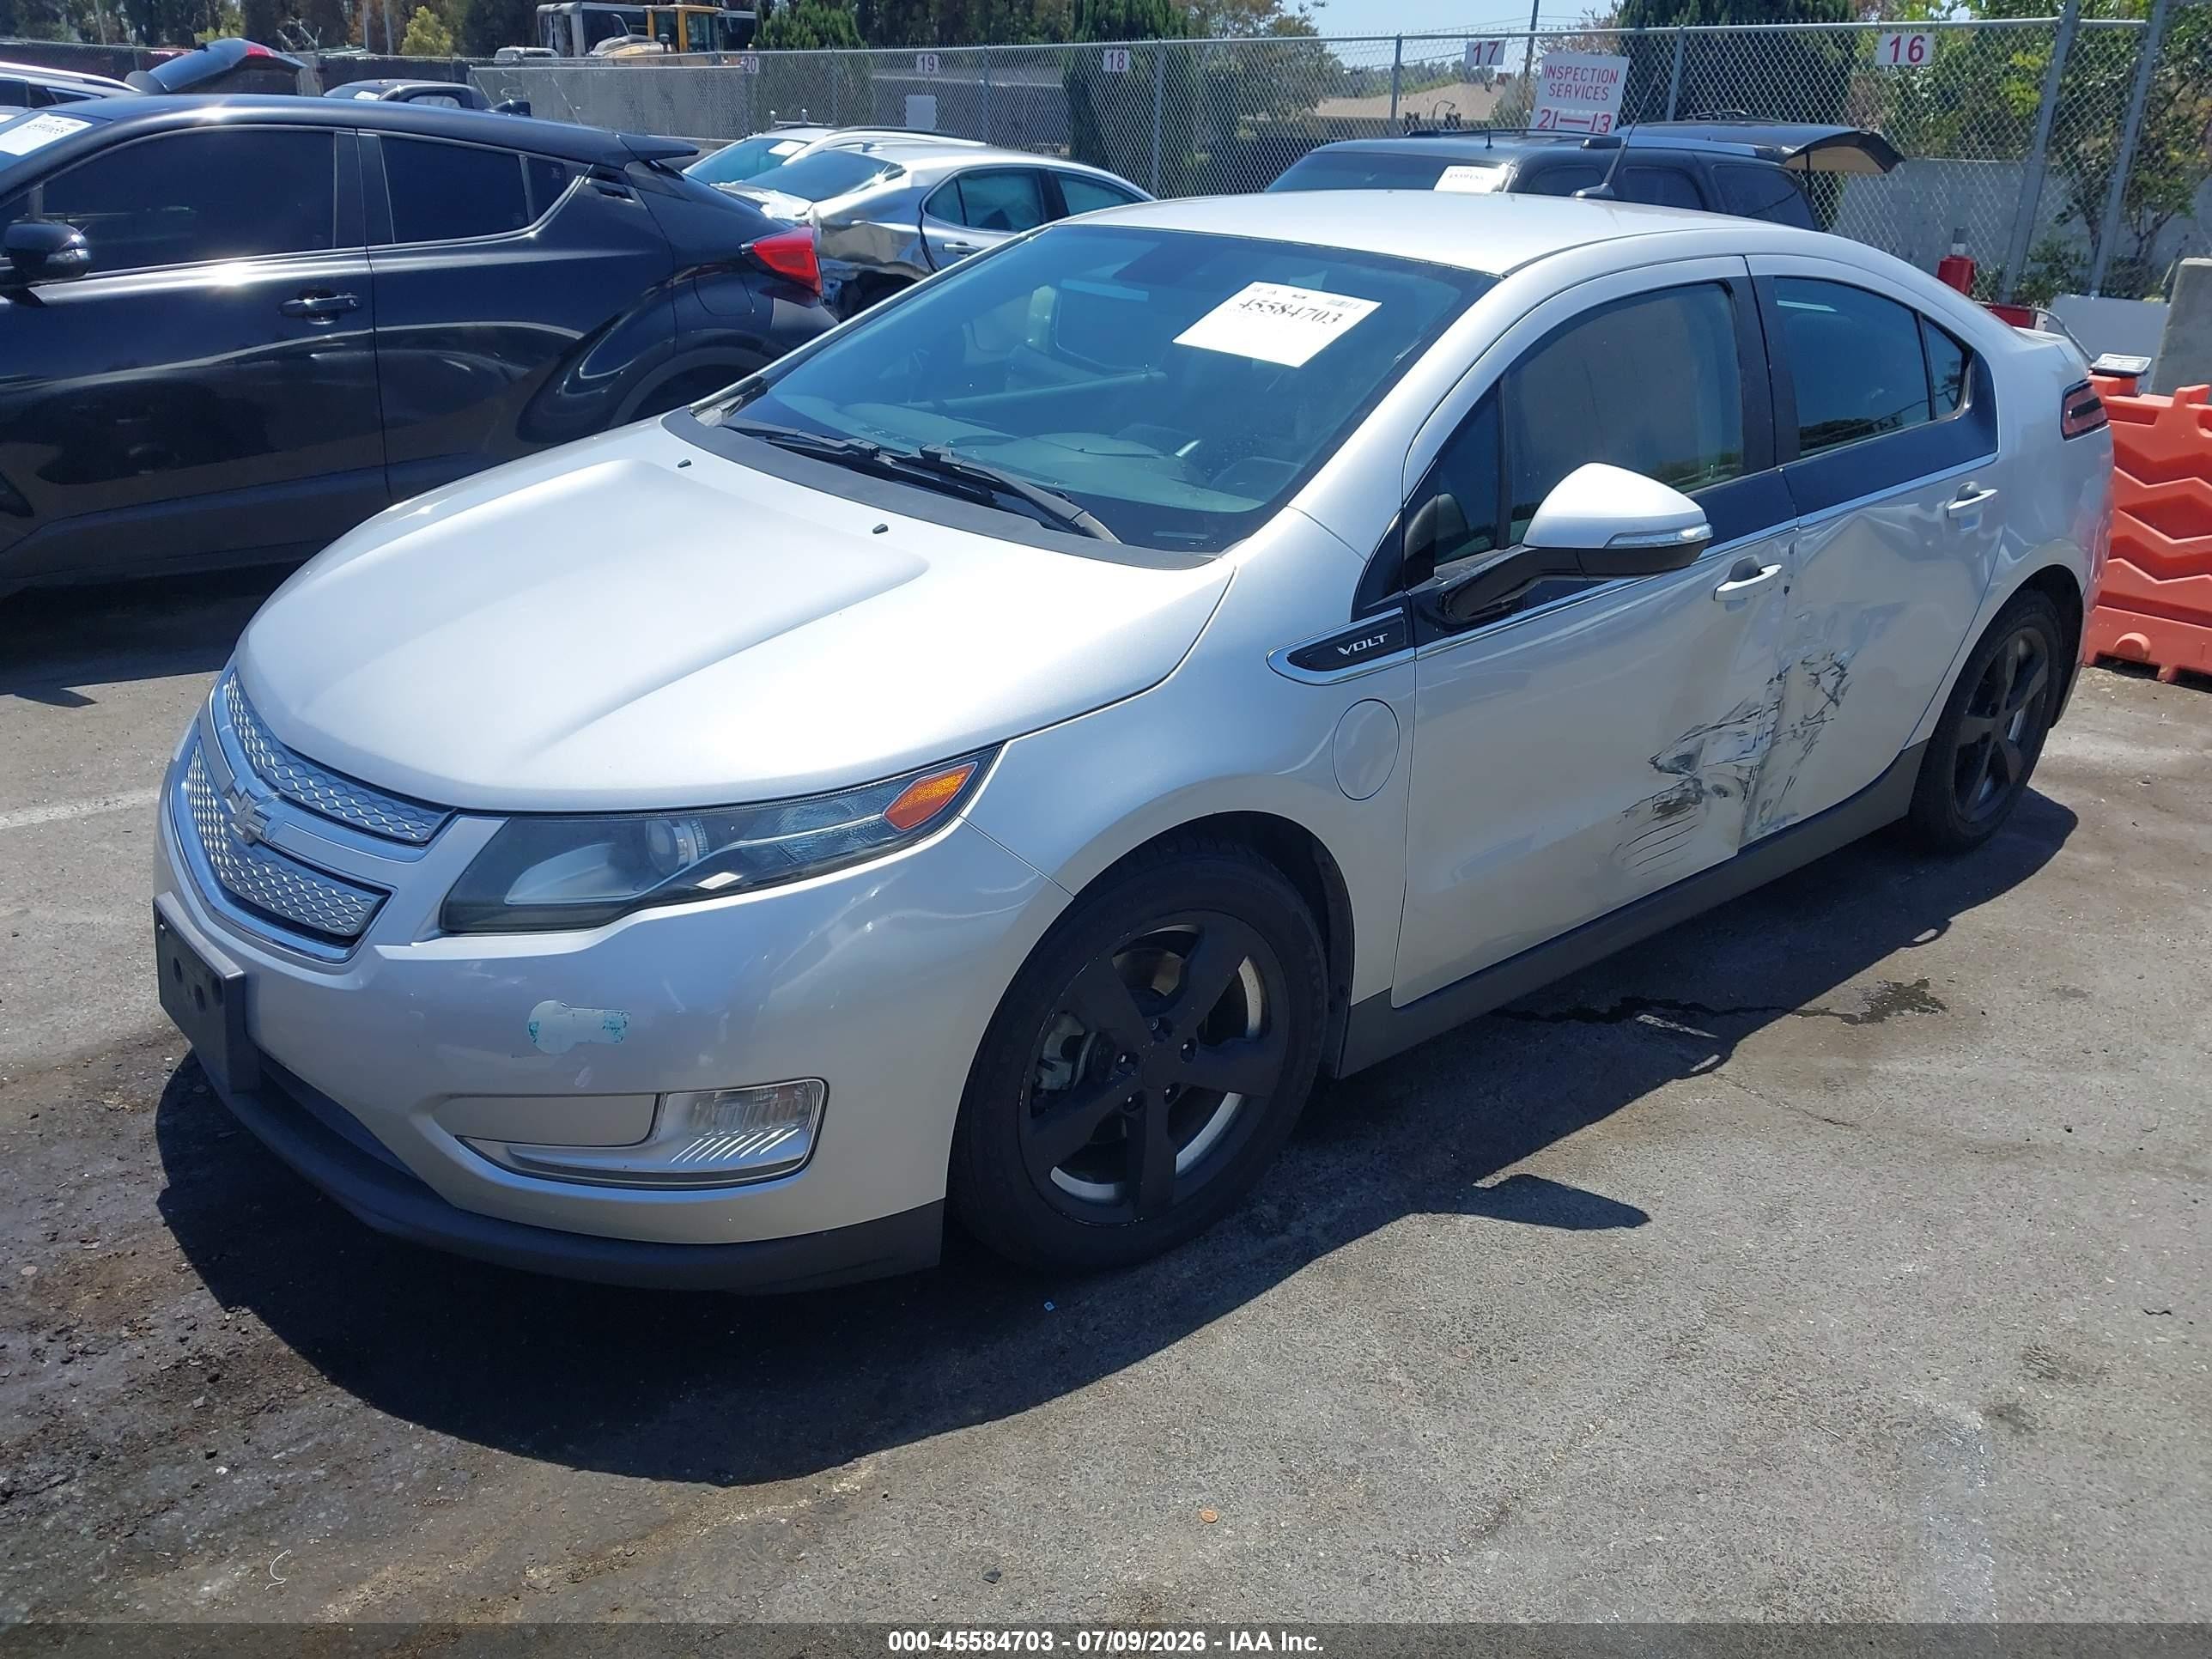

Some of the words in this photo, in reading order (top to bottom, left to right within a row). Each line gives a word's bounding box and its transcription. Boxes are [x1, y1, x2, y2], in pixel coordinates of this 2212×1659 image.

[1473, 40, 1499, 65] 17
[1889, 34, 1925, 64] 16
[744, 57, 757, 72] 20
[920, 54, 935, 72] 19
[1108, 51, 1125, 70] 18
[1544, 64, 1619, 83] INSPECTION
[1548, 82, 1609, 101] SERVICES
[1238, 298, 1343, 325] 45584703
[1336, 633, 1389, 656] VOLT
